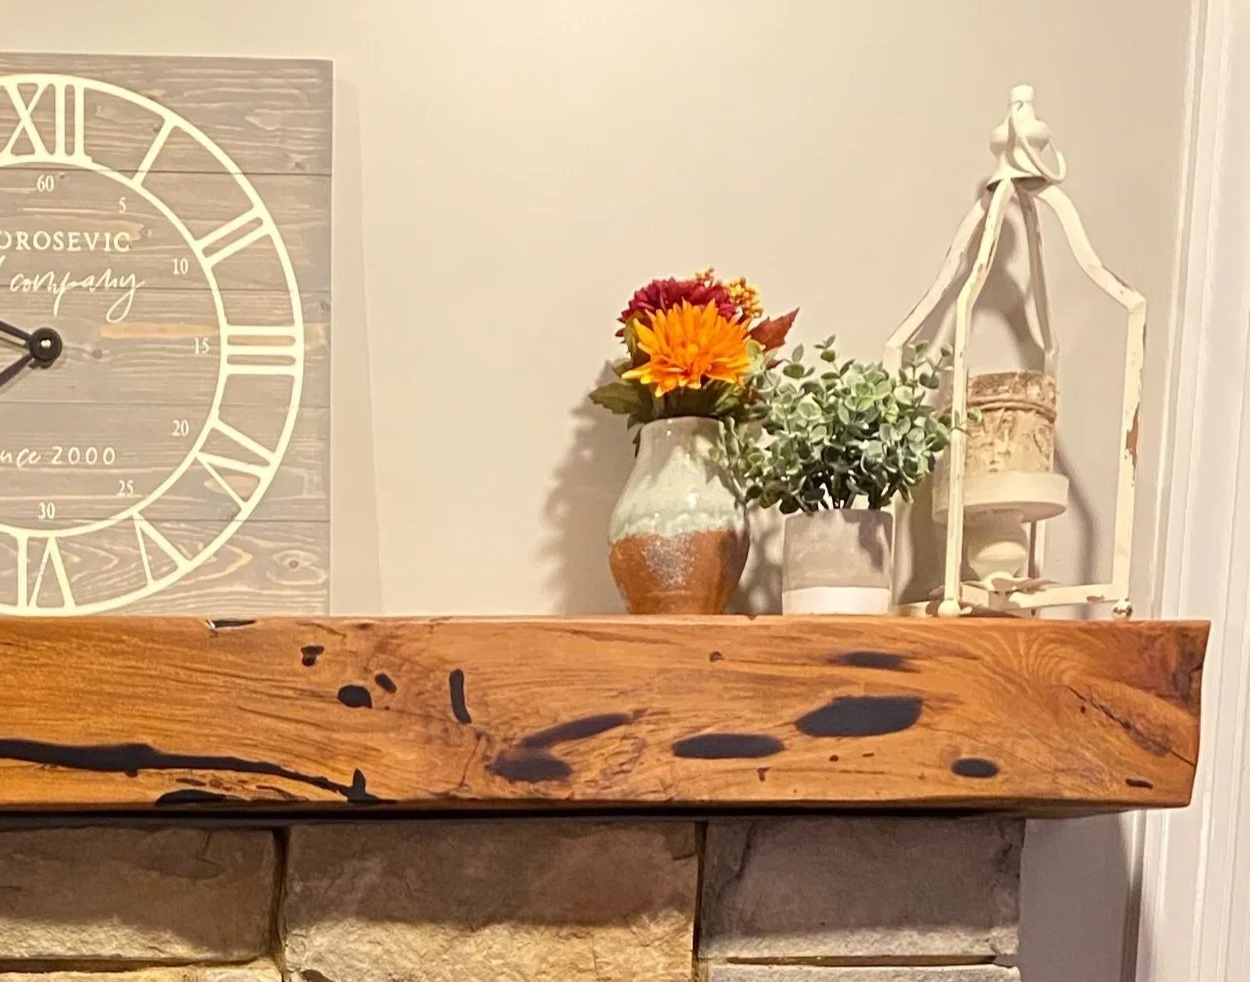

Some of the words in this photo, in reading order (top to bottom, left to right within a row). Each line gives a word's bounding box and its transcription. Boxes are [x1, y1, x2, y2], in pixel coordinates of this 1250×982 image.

[36, 175, 55, 193] 60
[118, 196, 127, 213] 5
[172, 257, 189, 275] 10
[9, 266, 146, 323] company
[193, 336, 210, 354] 15
[171, 419, 190, 437] 20
[50, 446, 117, 465] 2000
[118, 479, 135, 497] 25
[37, 502, 56, 520] 30
